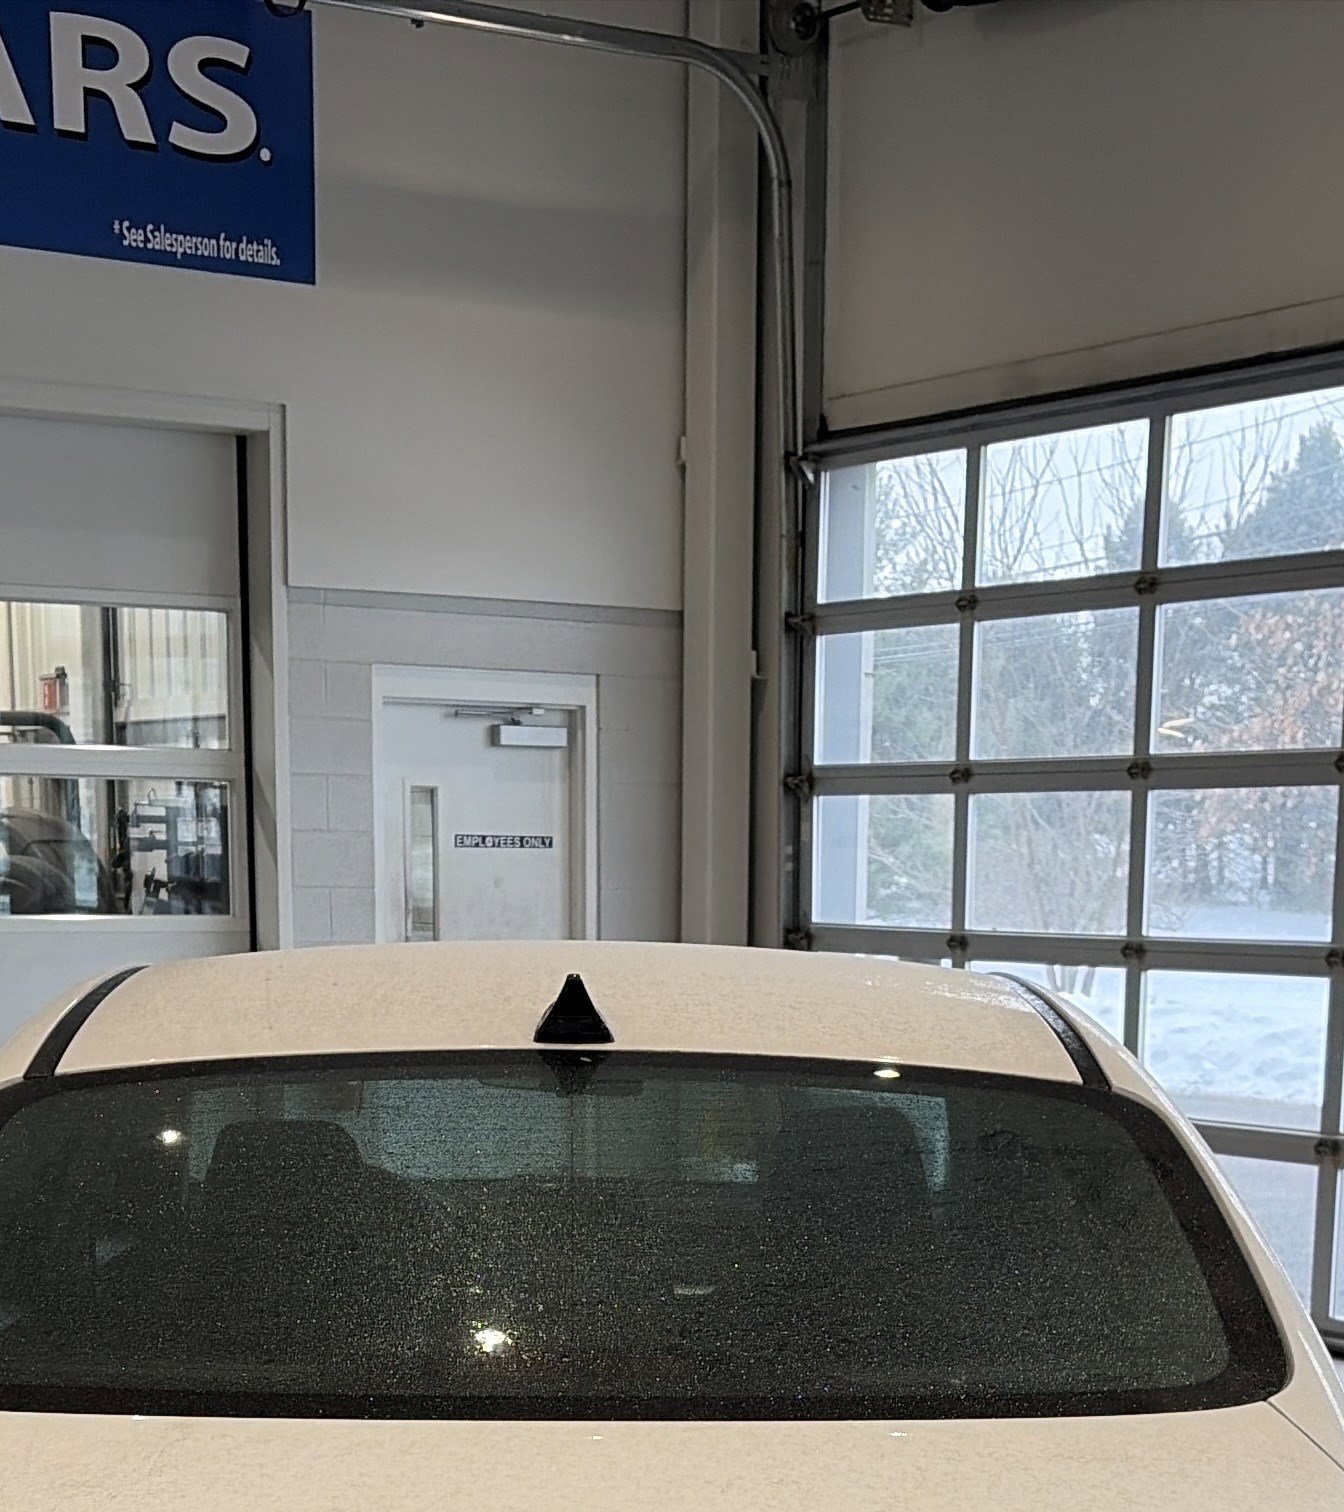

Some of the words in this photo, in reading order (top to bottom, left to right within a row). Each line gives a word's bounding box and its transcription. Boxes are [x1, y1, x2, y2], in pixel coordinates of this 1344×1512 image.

[146, 223, 218, 259] Salesperson
[219, 232, 236, 260] for
[239, 236, 281, 266] details.
[456, 835, 521, 848] EMPLOYEES
[523, 836, 551, 848] ONLY
